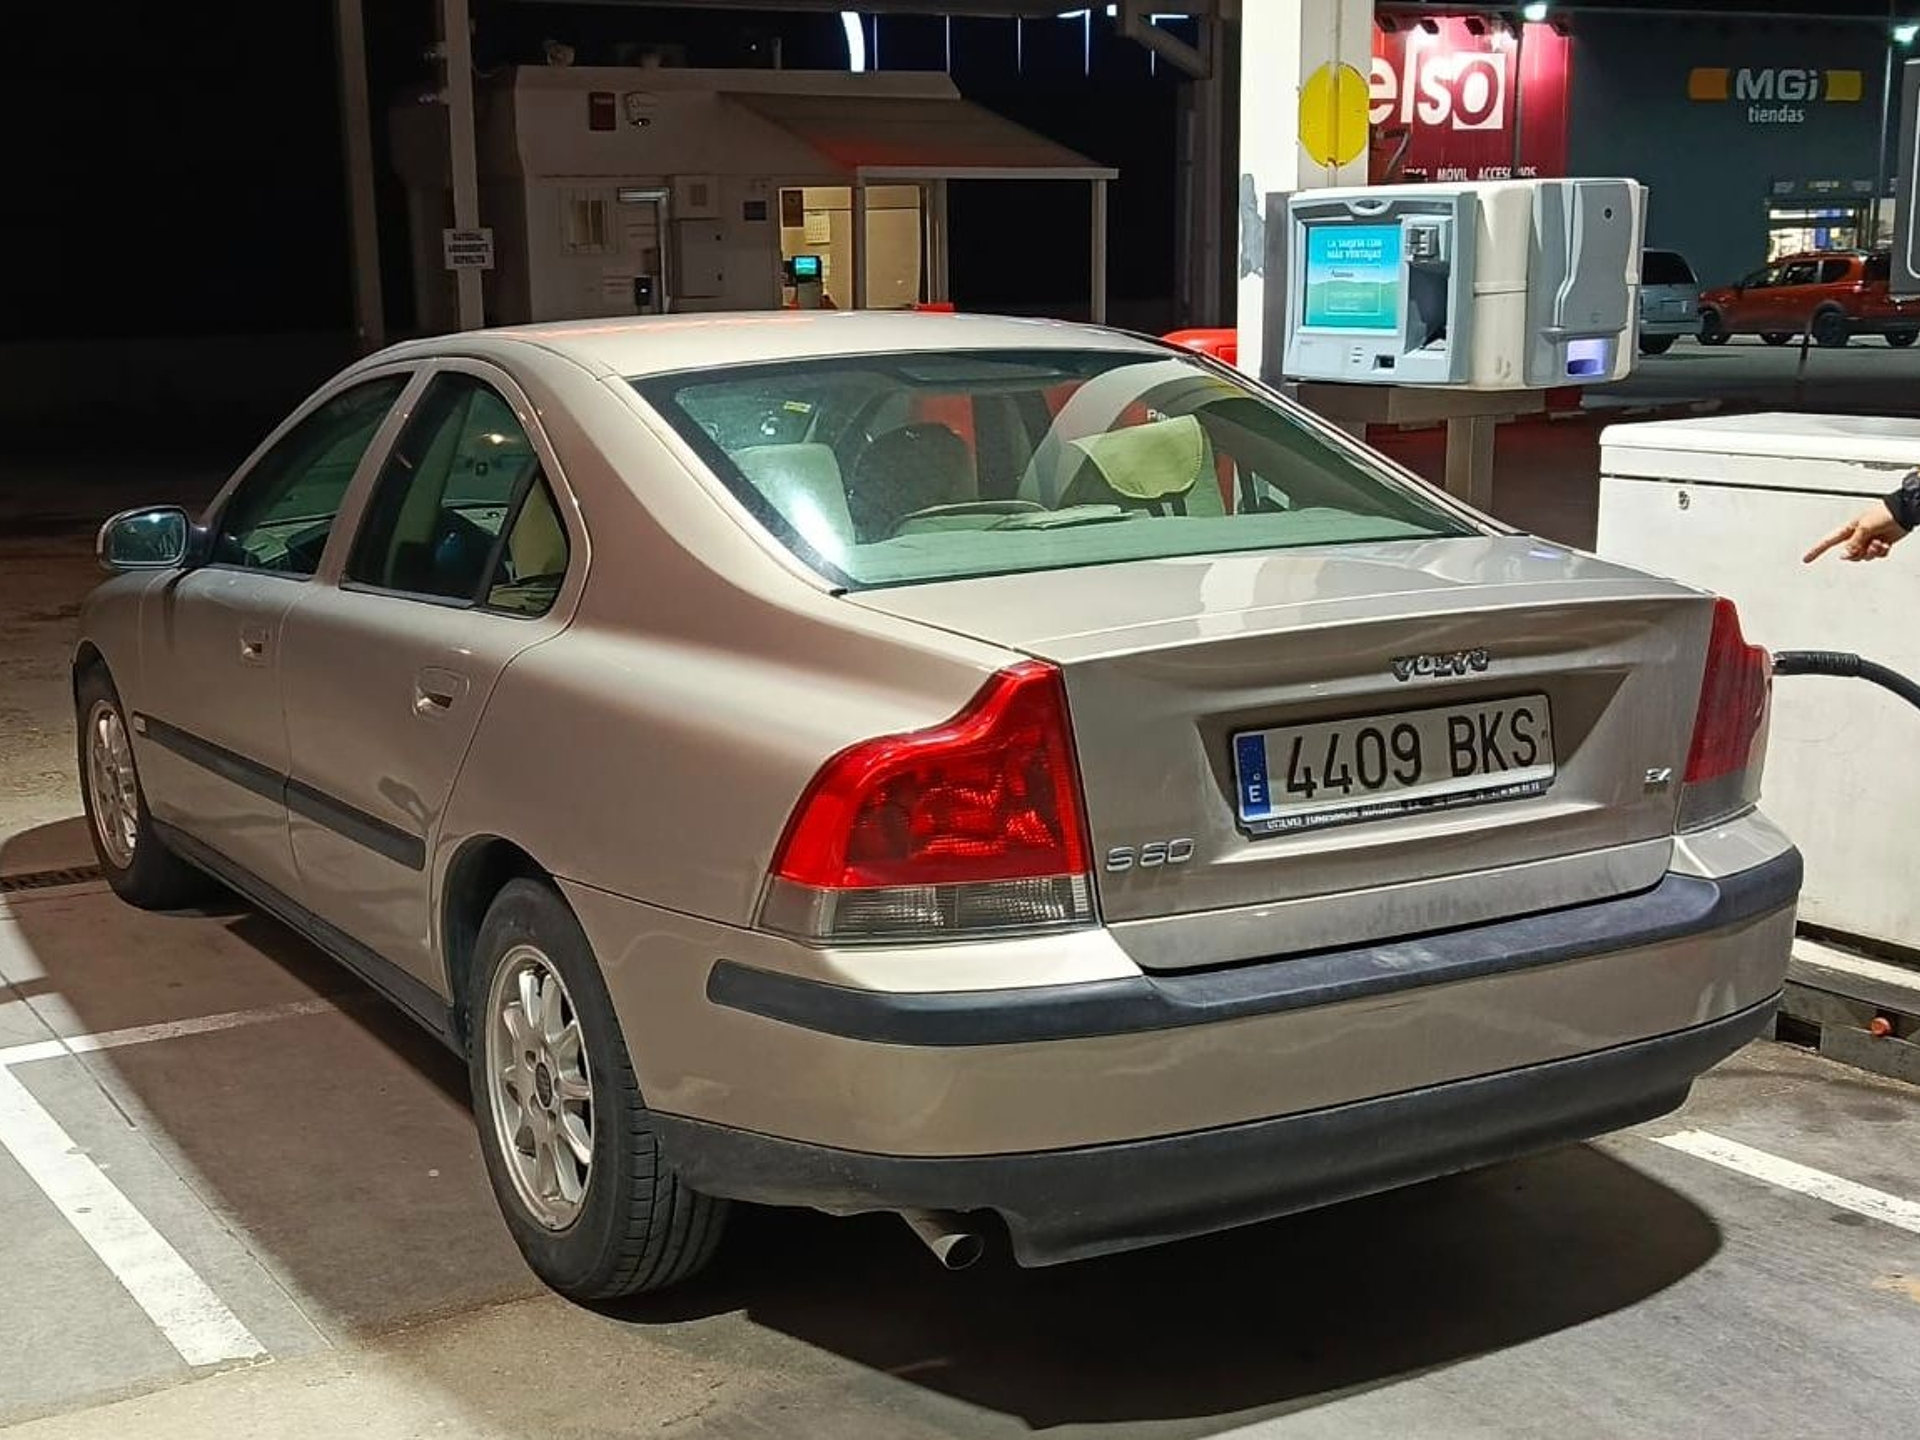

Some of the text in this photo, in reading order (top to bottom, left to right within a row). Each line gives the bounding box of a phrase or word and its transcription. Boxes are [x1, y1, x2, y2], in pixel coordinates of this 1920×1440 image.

[1748, 105, 1805, 123] tiendas
[1390, 649, 1489, 681] VOLVO
[1286, 707, 1537, 799] 4409 BKS
[1248, 784, 1262, 803] E
